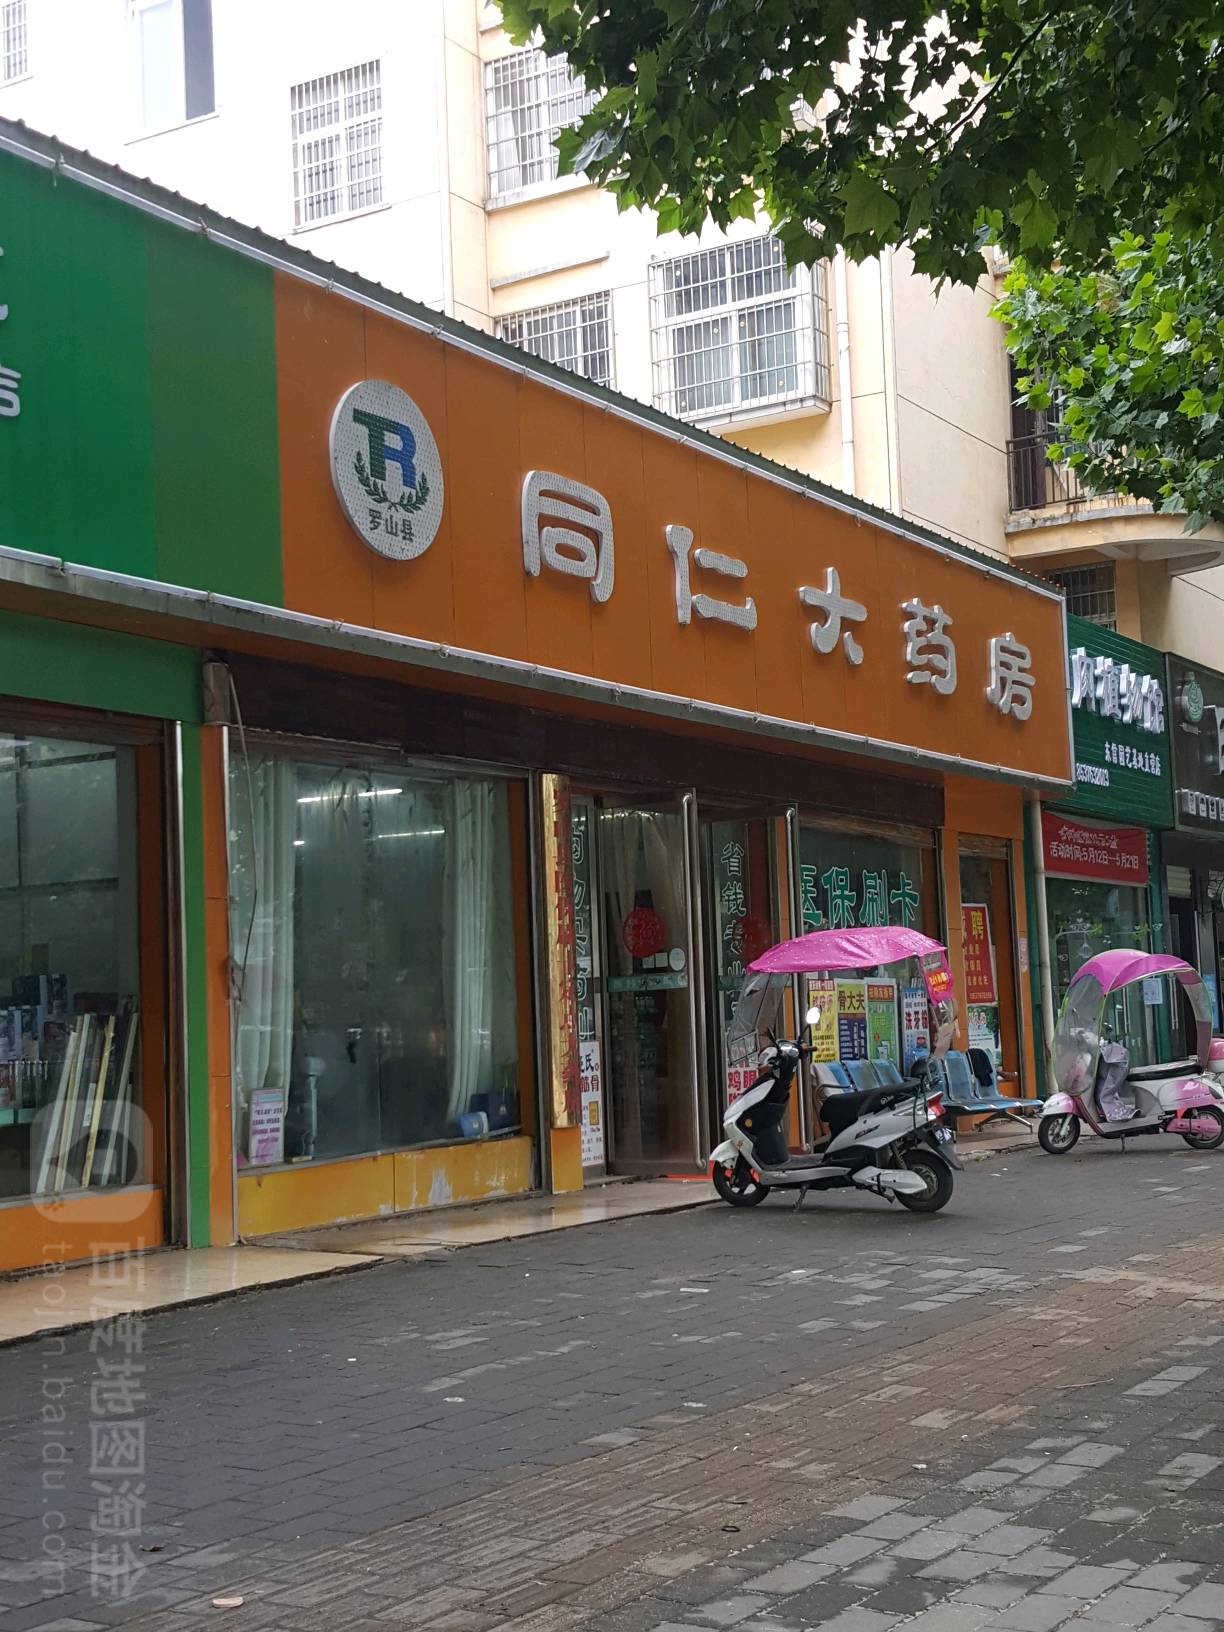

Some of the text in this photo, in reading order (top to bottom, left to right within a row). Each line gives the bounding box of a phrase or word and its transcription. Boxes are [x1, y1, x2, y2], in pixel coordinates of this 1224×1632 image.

[352, 407, 417, 490] TR
[368, 508, 415, 543] 罗山县
[521, 469, 1036, 722] 同仁大药房
[800, 864, 920, 930] 医保刷卡
[728, 1069, 757, 1091] 鸡眼
